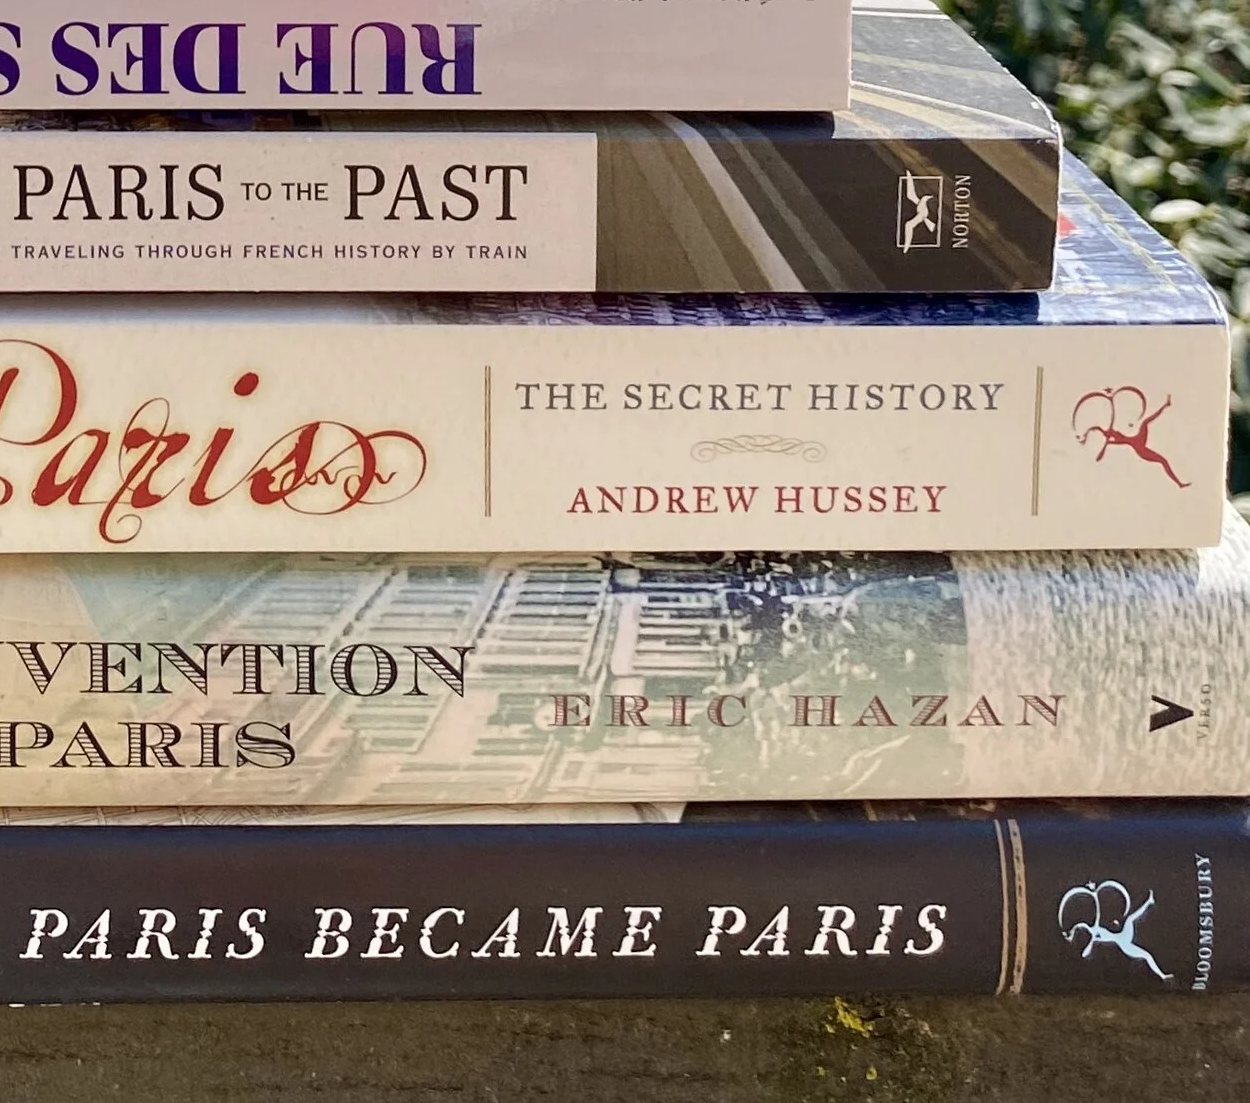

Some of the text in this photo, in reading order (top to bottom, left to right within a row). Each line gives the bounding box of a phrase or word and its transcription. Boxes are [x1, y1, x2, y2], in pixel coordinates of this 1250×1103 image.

[51, 21, 247, 97] DES
[276, 21, 483, 96] RUE
[13, 163, 529, 222] PARIS TO THE PAST
[952, 174, 972, 248] NORTON
[11, 244, 528, 260] TRAVELING THROUGH FRENCH HISTORY BY TRAIN
[516, 383, 1006, 412] THE SECRET HISTORY
[566, 486, 948, 515] ANDREW HUSSEY
[549, 694, 1066, 728] ERIC HAZAN
[1196, 683, 1212, 740] VERSO
[18, 907, 268, 960] PARIS
[303, 906, 664, 960] BECAME
[695, 904, 948, 957] PARIS
[1192, 853, 1214, 991] BLOOMSBURY
